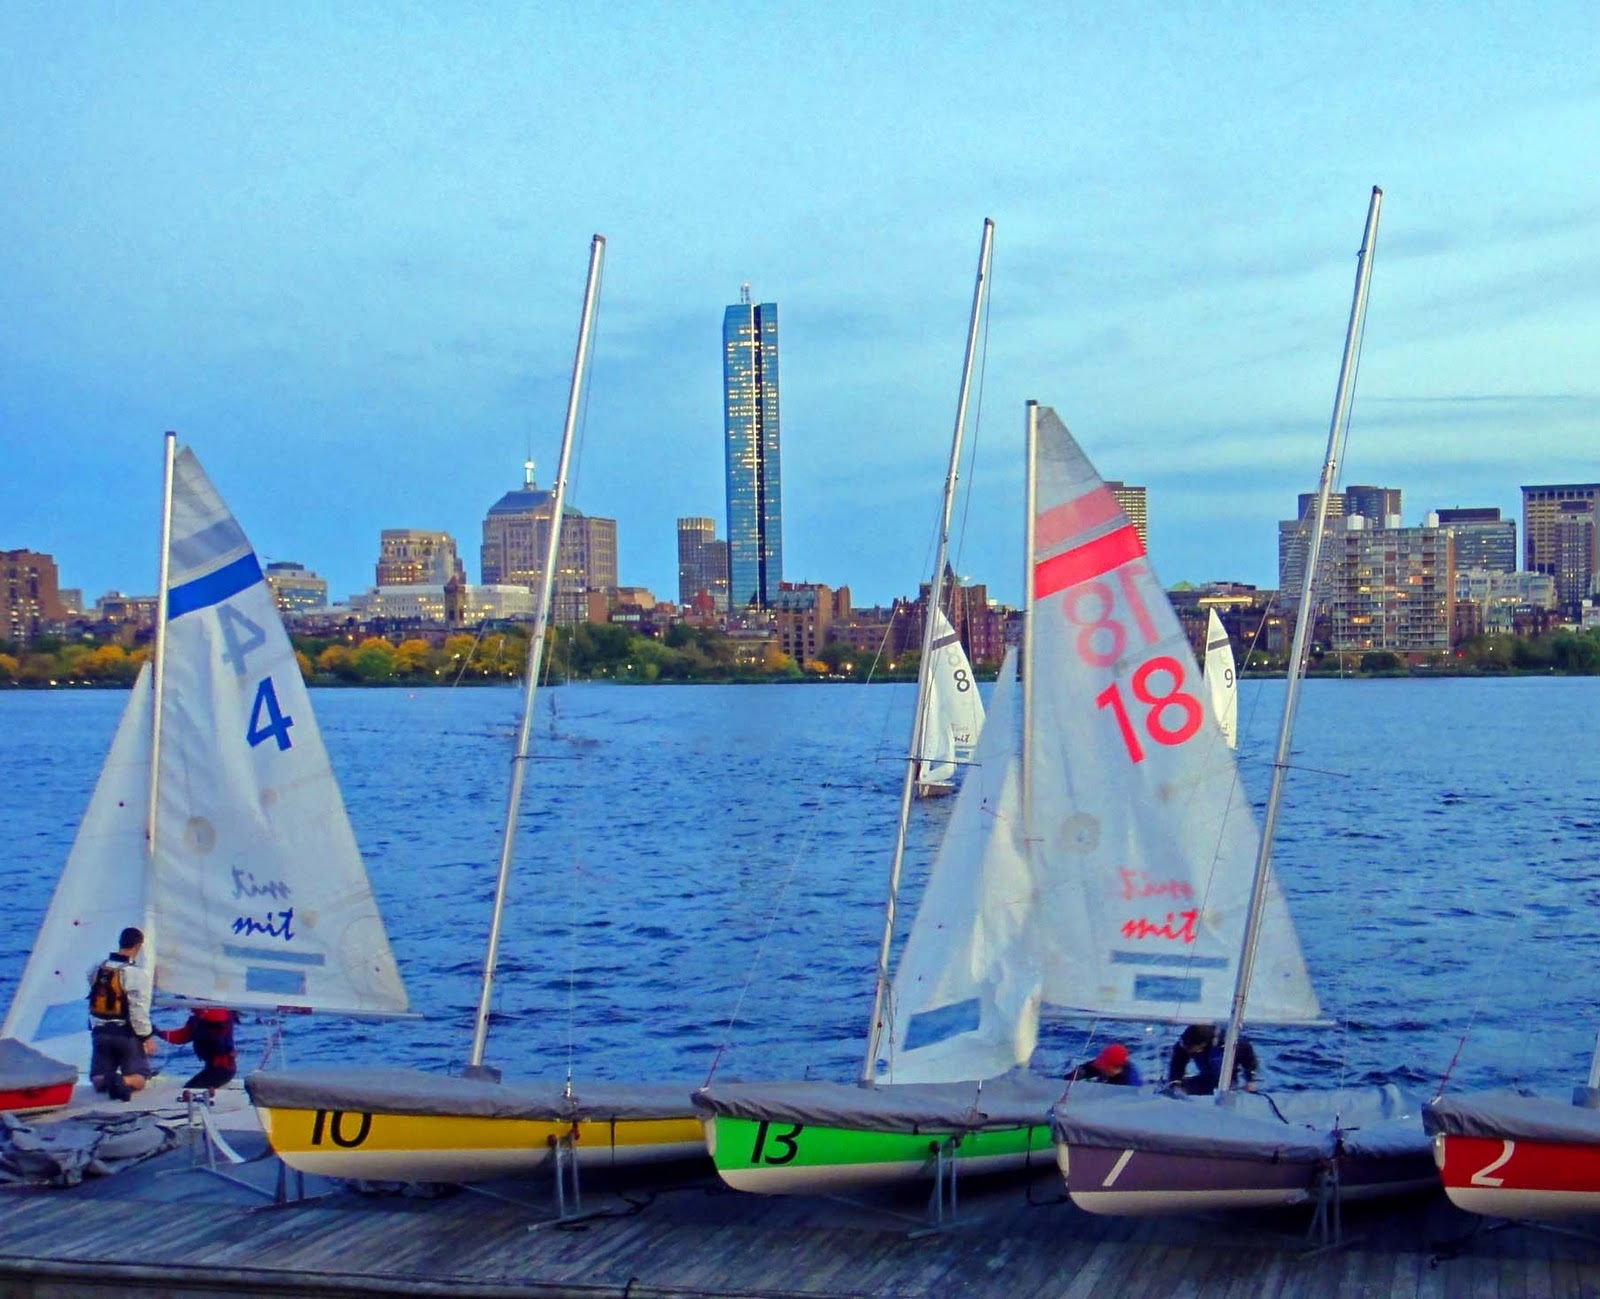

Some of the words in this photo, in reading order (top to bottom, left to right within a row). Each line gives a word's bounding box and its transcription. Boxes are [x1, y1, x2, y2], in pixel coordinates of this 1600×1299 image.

[953, 669, 971, 693] 8
[1224, 668, 1234, 689] 9
[247, 676, 294, 751] 4
[1095, 656, 1203, 764] 18
[231, 906, 295, 941] mit
[1120, 907, 1199, 944] mit
[311, 1108, 372, 1148] 10
[750, 1118, 804, 1165] 13
[1470, 1139, 1515, 1187] 2
